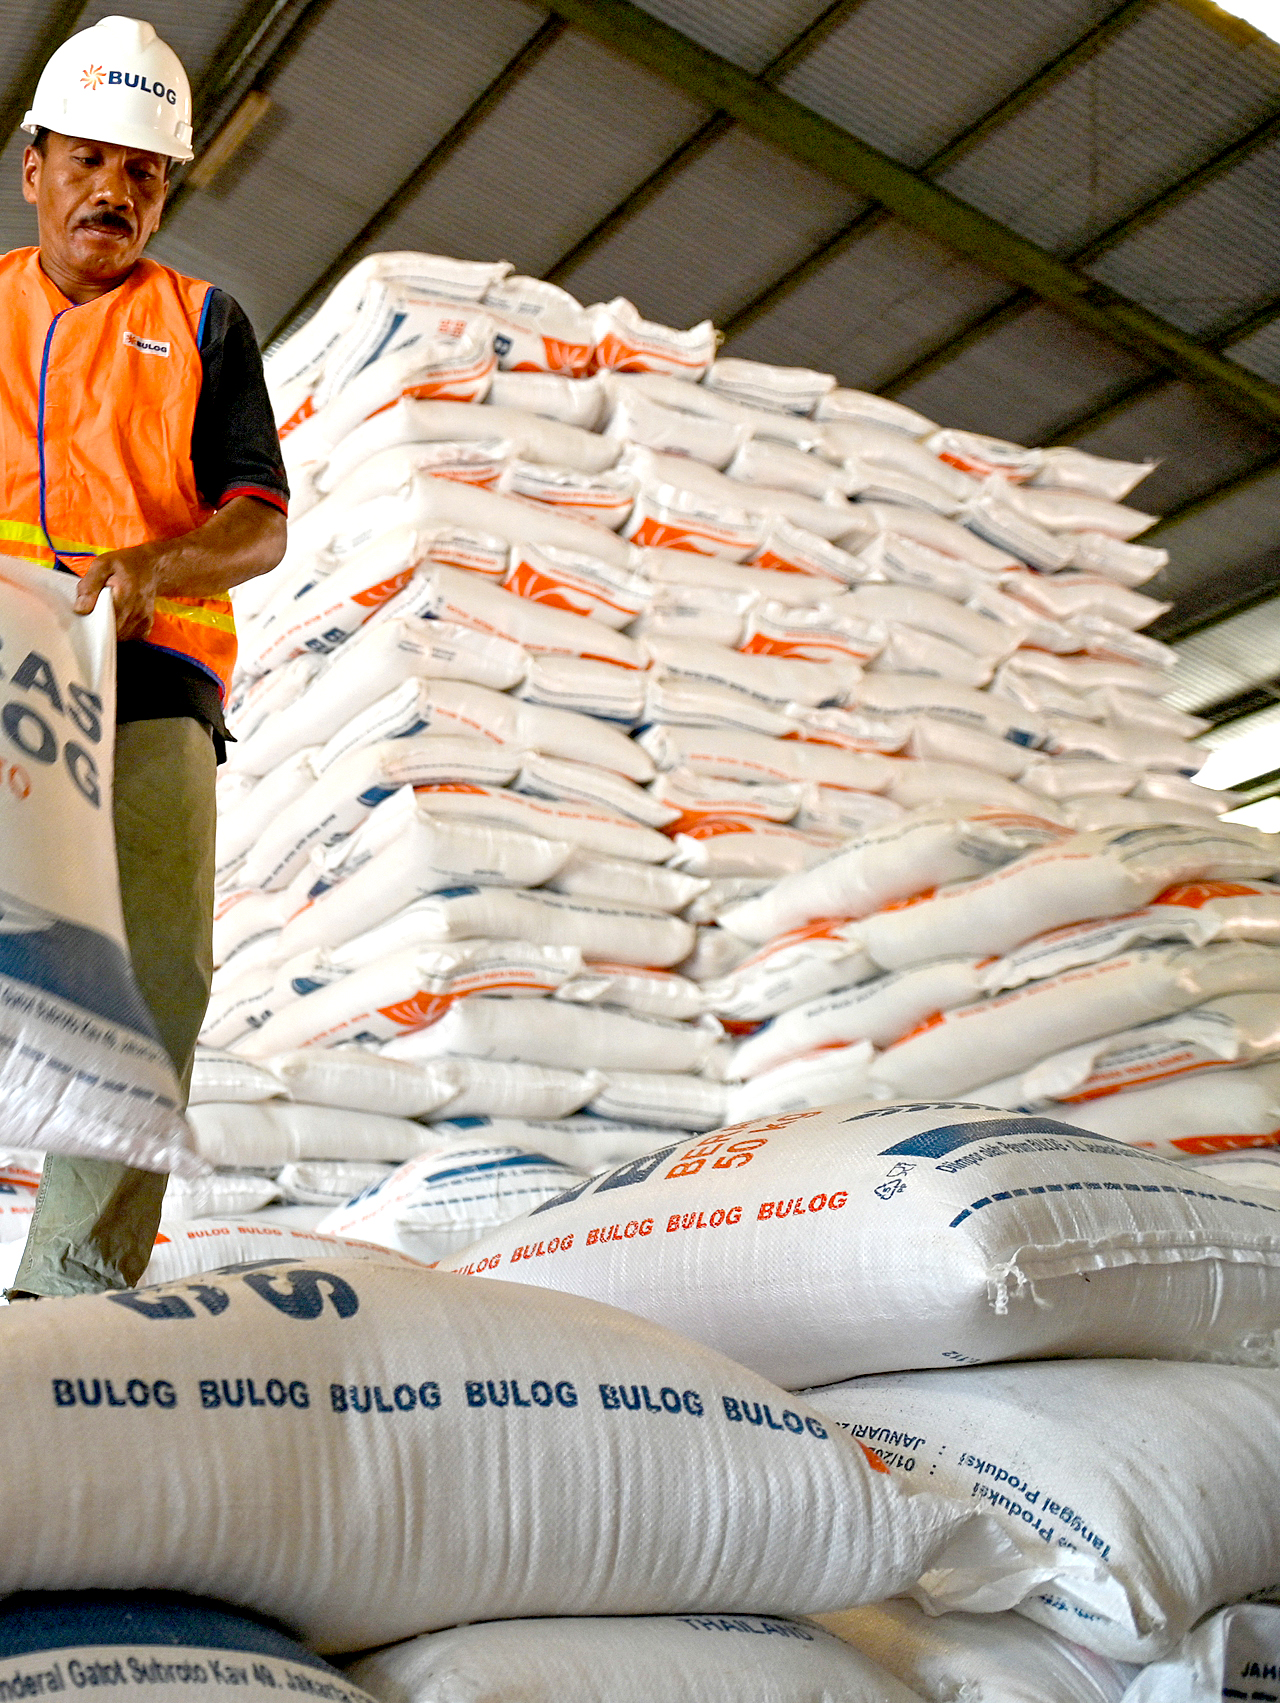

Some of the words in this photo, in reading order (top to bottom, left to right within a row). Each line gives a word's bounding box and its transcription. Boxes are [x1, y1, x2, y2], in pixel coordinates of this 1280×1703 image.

[108, 70, 177, 105] BULOG
[136, 340, 168, 353] BULOG
[712, 1138, 769, 1169] 50
[747, 1110, 823, 1134] kg
[187, 1227, 231, 1240] BULOG
[237, 1225, 283, 1237] BULOG
[451, 1253, 503, 1276] ULOG
[510, 1233, 575, 1264] BULOG
[586, 1217, 655, 1247] BULOG
[666, 1206, 744, 1233] BULOG
[756, 1190, 850, 1221] BULOG
[52, 1378, 179, 1410] BULOG
[199, 1378, 310, 1410] BULOG
[330, 1381, 442, 1414] BULOG
[465, 1379, 579, 1409] BULOG
[598, 1384, 705, 1418] BULOG
[721, 1395, 829, 1441] BULOG
[851, 1424, 926, 1451] JANUARI
[957, 1452, 1041, 1505] Produksi
[971, 1482, 1055, 1544] Produksi
[676, 1618, 815, 1642] THAILAND
[1241, 1661, 1280, 1680] JAH
